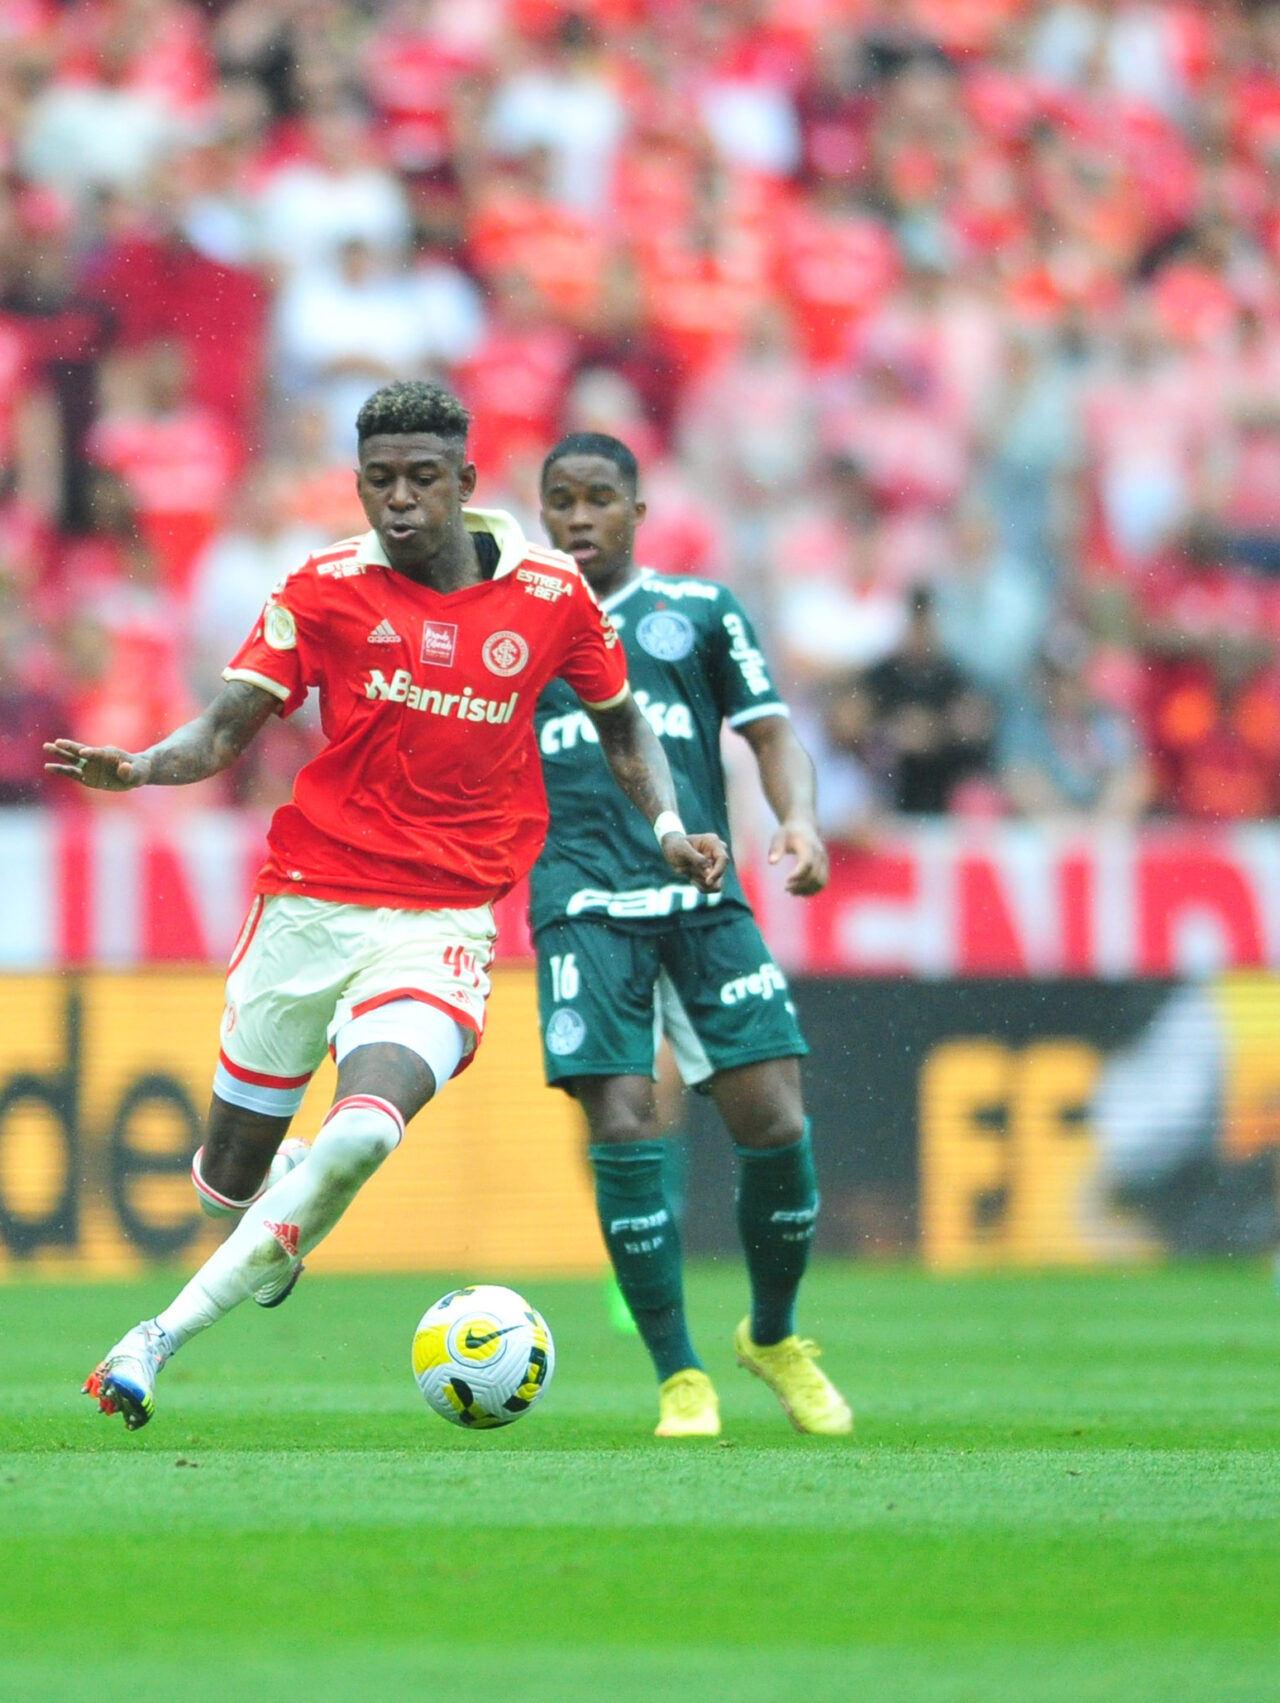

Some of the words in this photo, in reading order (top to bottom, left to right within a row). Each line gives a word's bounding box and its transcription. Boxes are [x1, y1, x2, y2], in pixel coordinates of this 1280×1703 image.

[515, 569, 574, 597] ESTRELA
[534, 586, 562, 603] BET
[387, 668, 519, 725] Banrisul
[549, 953, 580, 1003] 16
